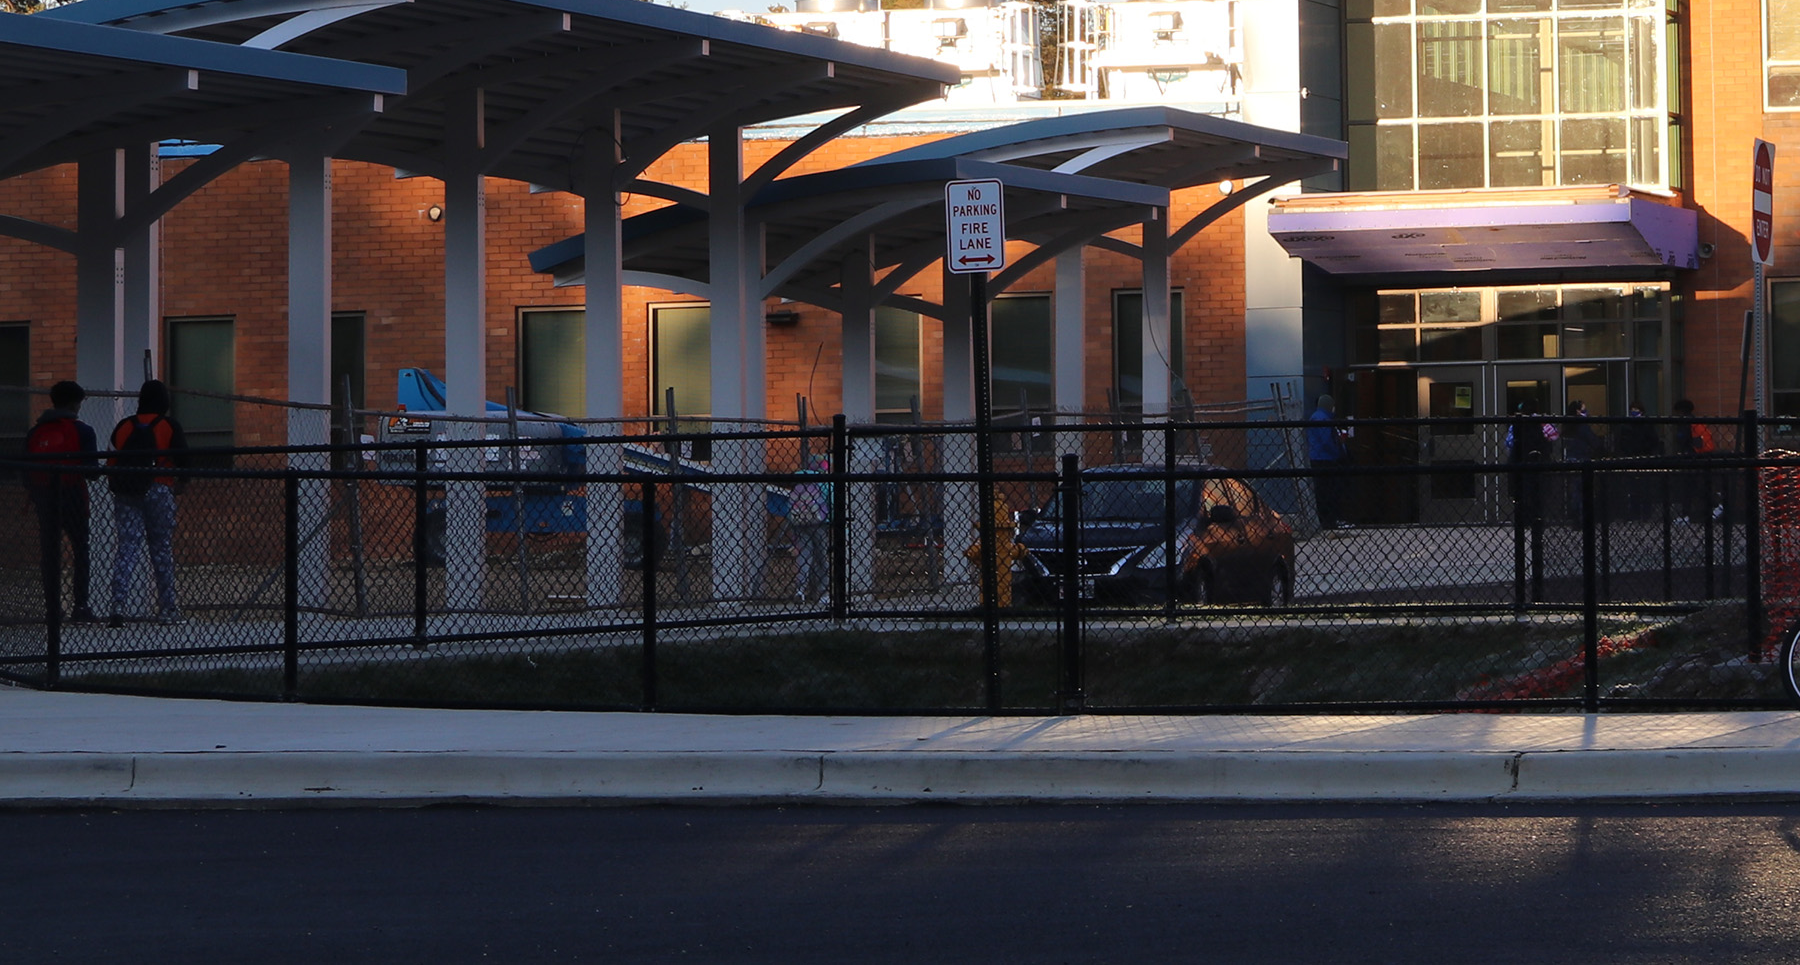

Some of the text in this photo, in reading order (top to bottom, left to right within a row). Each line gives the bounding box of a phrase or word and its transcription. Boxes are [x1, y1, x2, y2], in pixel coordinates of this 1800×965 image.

[968, 189, 981, 201] NO
[953, 203, 997, 217] PARKING
[961, 222, 989, 235] FIRE
[960, 237, 992, 251] LANE
